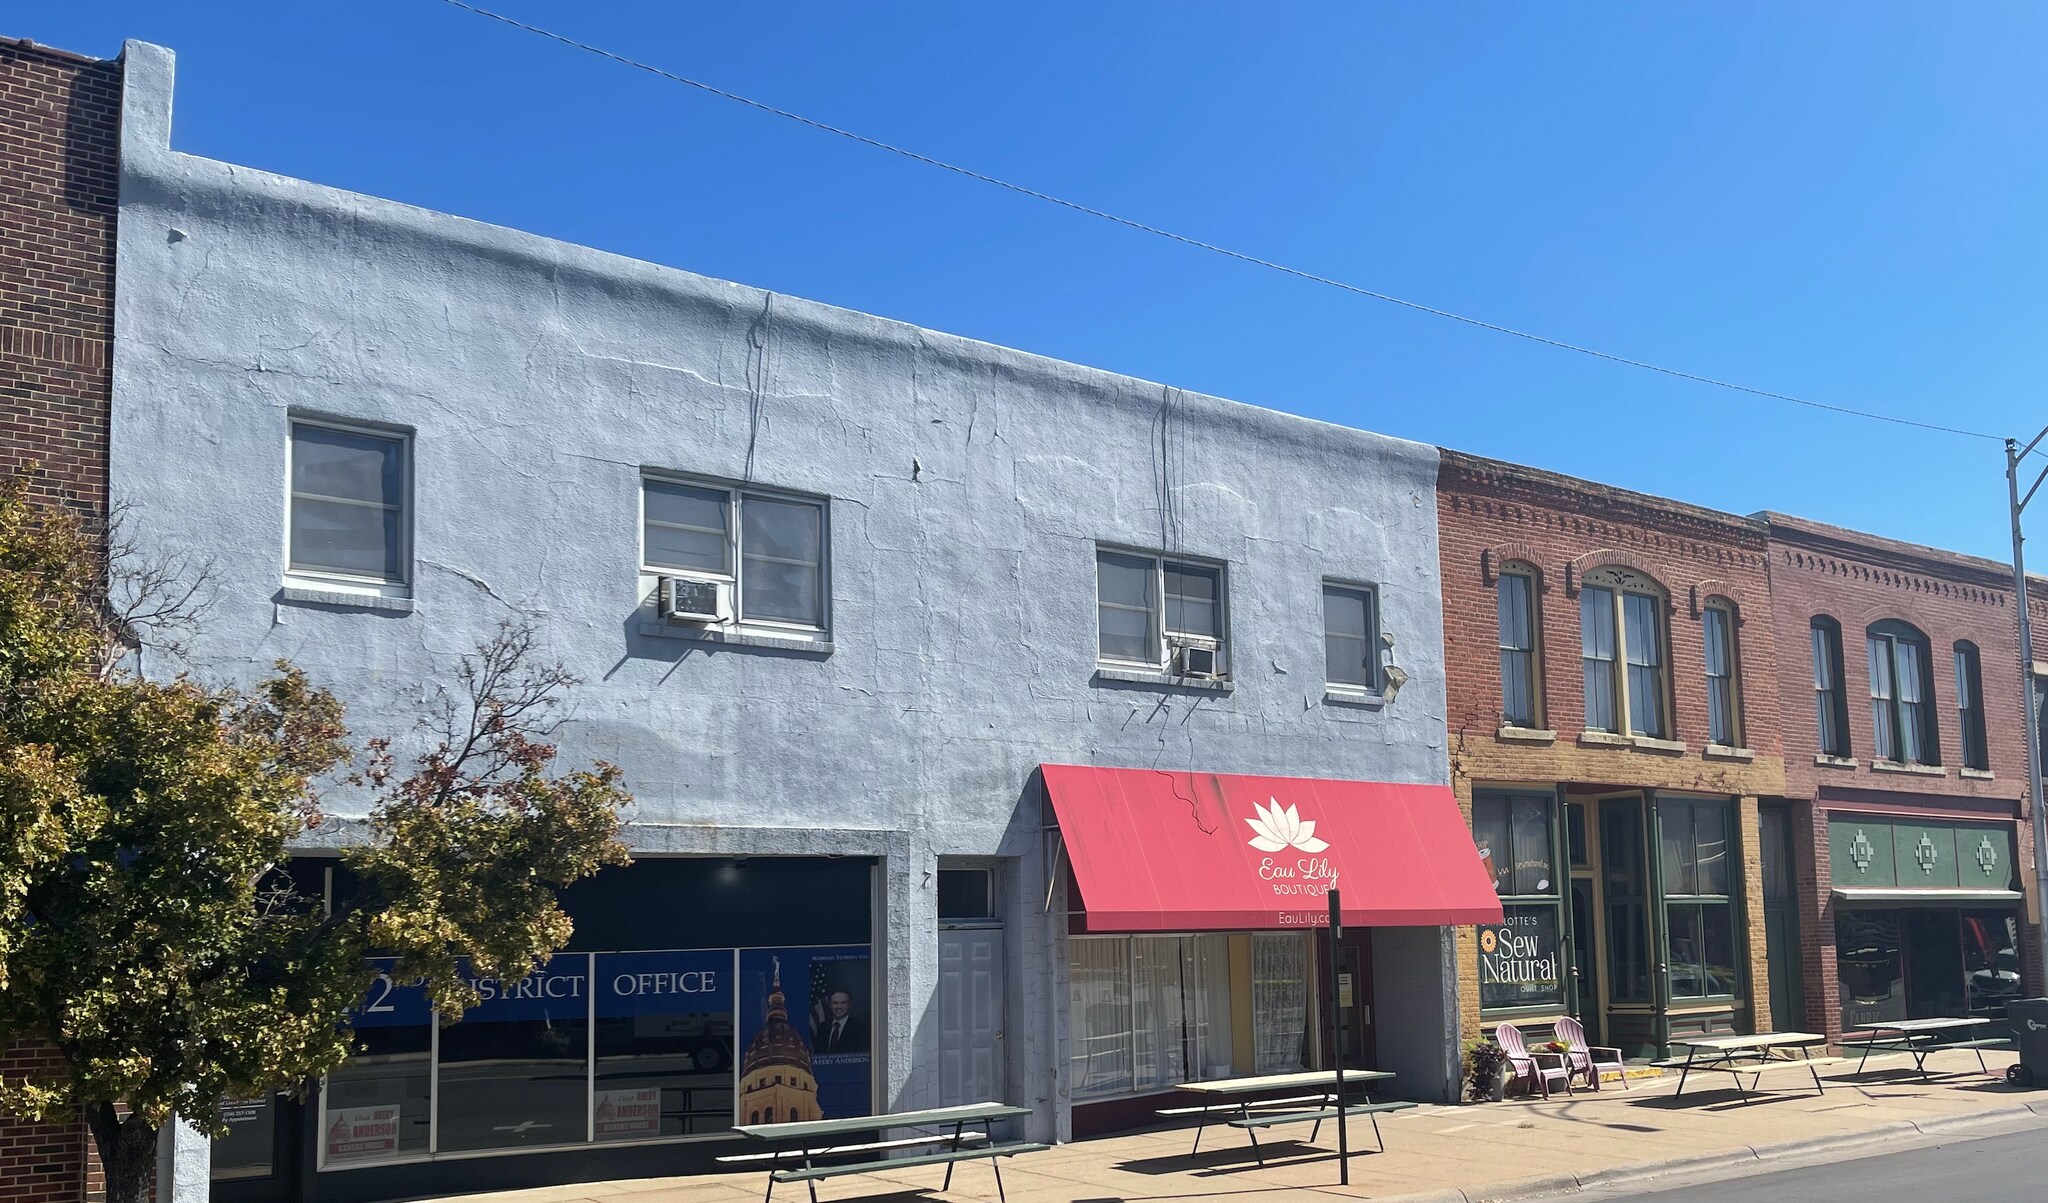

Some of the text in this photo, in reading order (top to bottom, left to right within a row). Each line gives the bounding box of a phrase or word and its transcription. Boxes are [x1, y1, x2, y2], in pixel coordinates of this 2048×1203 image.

[1259, 857, 1340, 890] Eau Lily
[1273, 884, 1330, 896] BOUTIQUE
[1279, 912, 1330, 926] EauLily.co
[1498, 928, 1538, 959] Sew
[1482, 951, 1556, 984] Natural
[469, 976, 584, 1000] ISTRICT
[613, 971, 717, 996] OFFICE
[1520, 984, 1558, 993] QUILT SHOP
[617, 1103, 659, 1118] ANDERSON
[352, 1122, 397, 1138] ANDERSON
